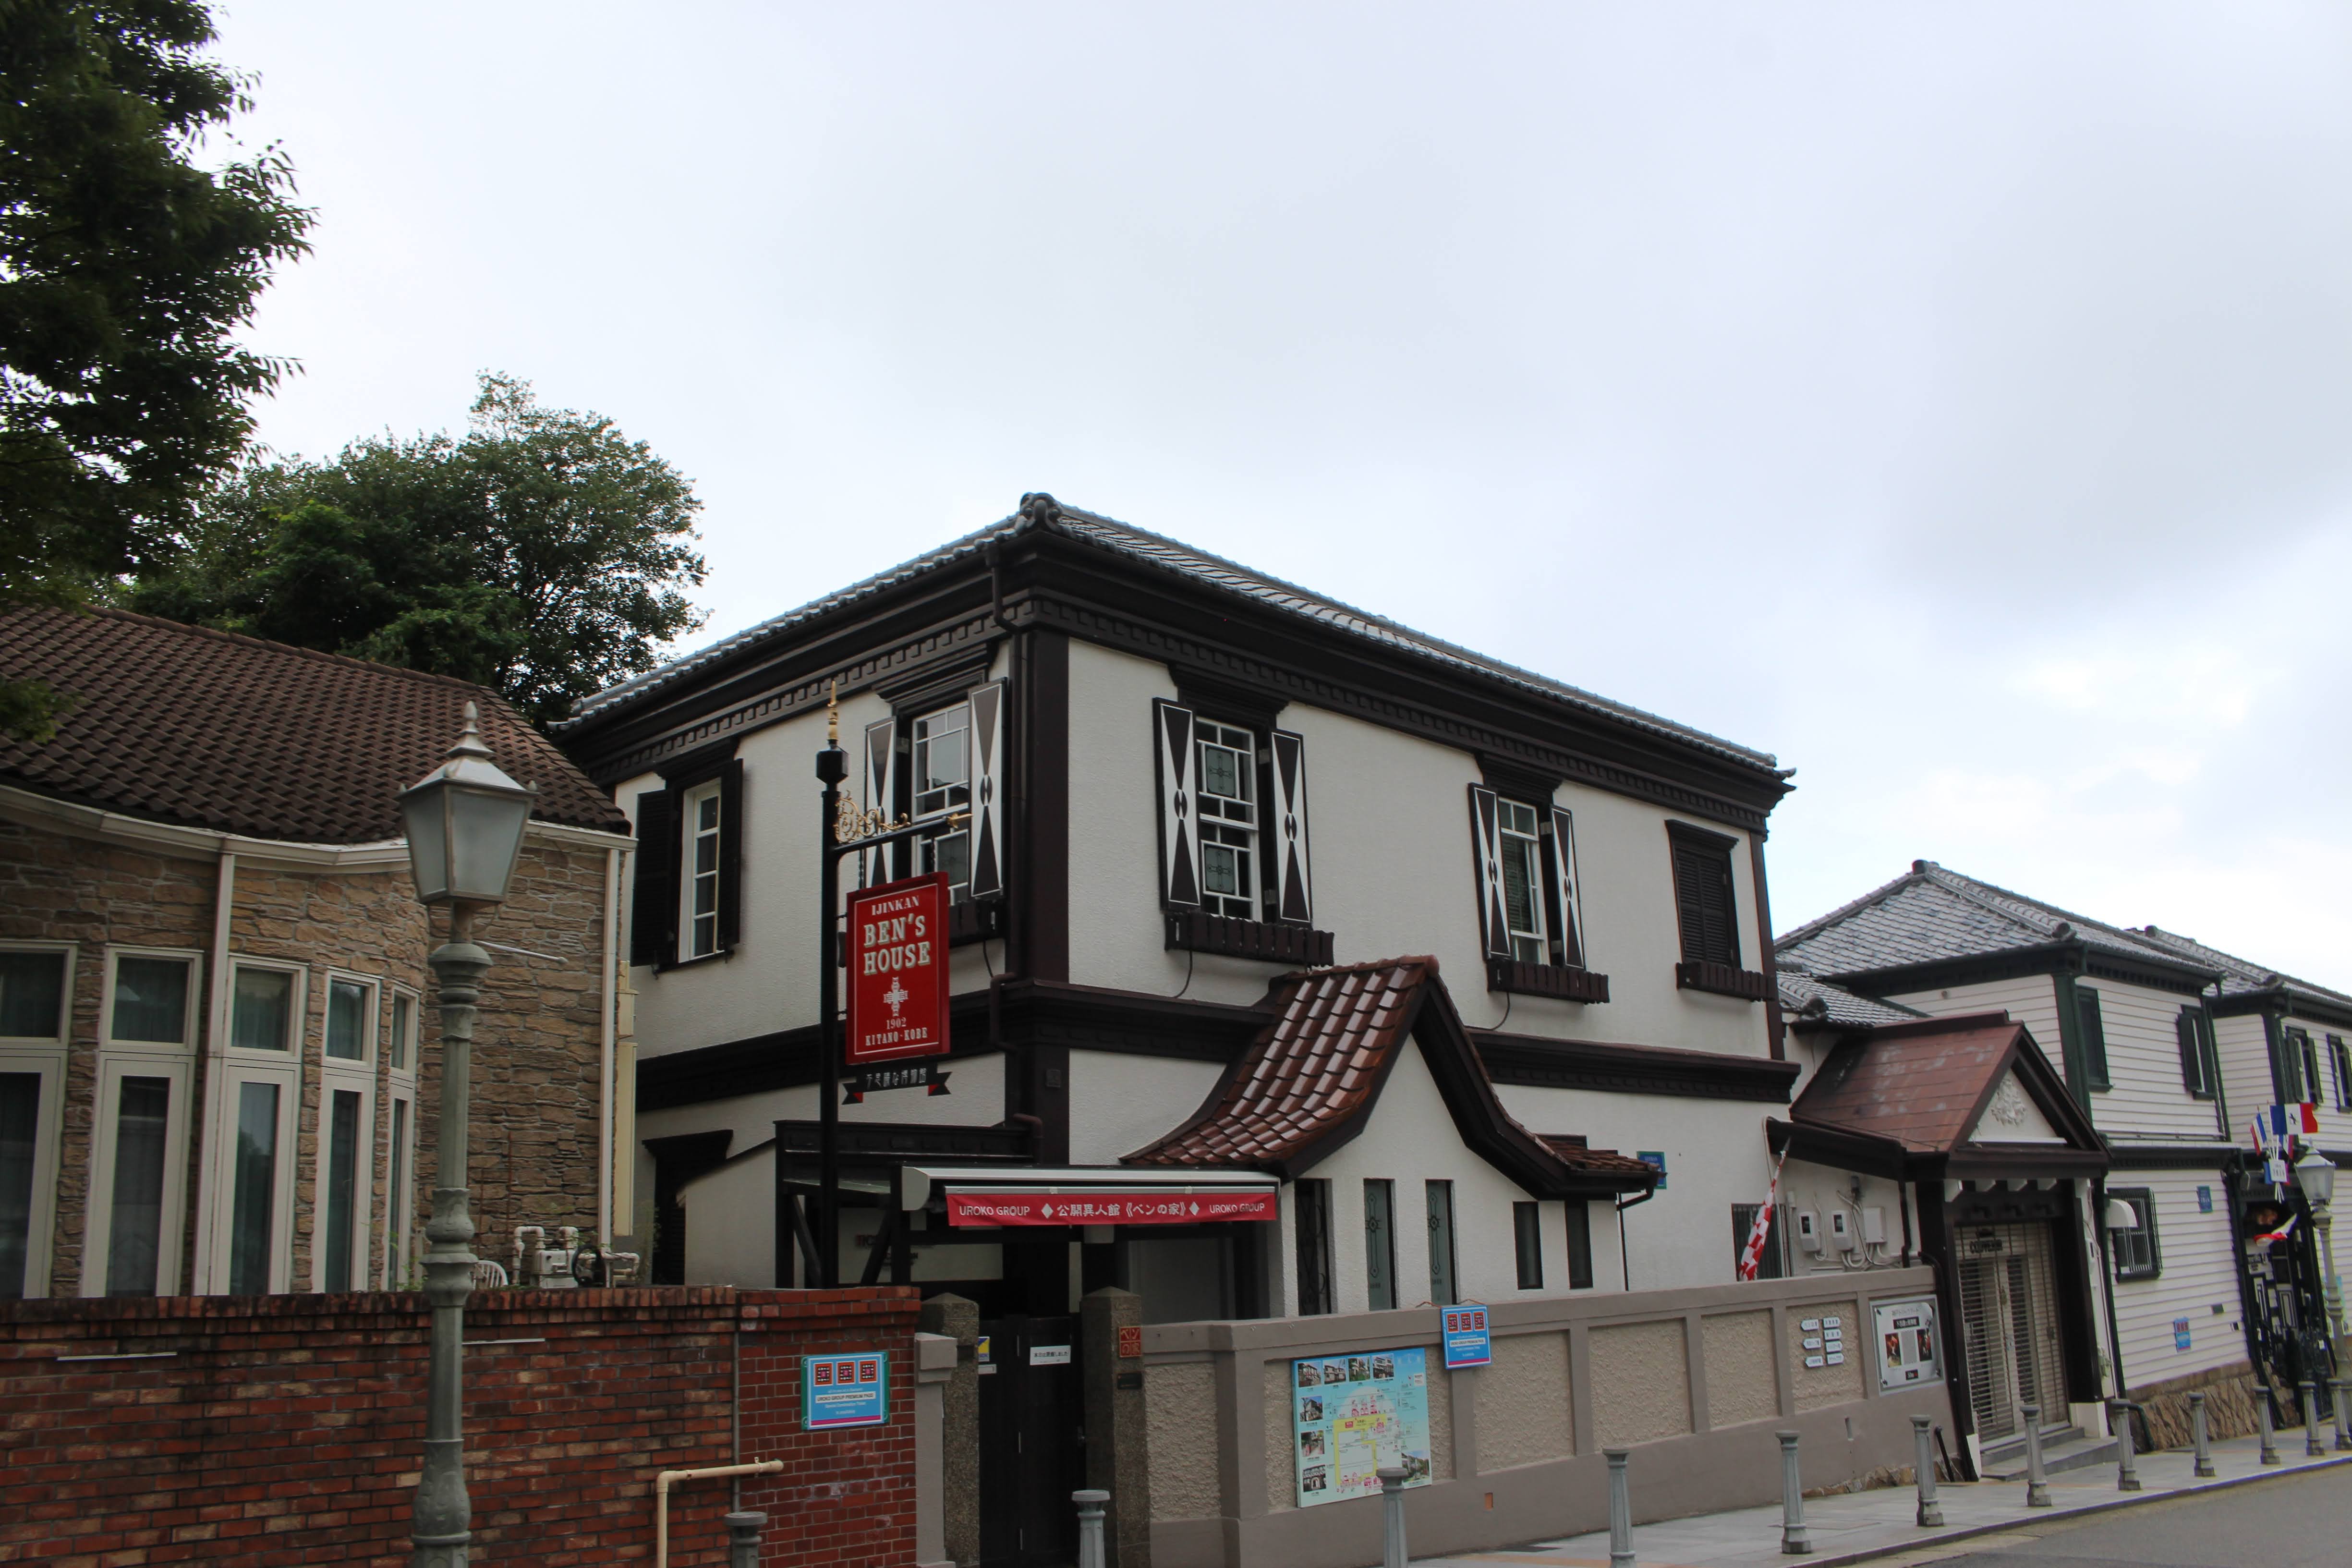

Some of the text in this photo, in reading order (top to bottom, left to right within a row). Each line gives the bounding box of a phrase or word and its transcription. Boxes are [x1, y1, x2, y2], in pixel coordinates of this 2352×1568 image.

[872, 895, 919, 915] IJINKAN
[864, 913, 925, 948] BEN'S
[864, 941, 930, 976] HOUSE
[886, 1017, 906, 1030] 1902
[959, 1206, 994, 1216] UROKO
[996, 1206, 1030, 1216] GROUP
[1210, 1203, 1237, 1214] UROKO
[1239, 1203, 1265, 1212] GROUP
